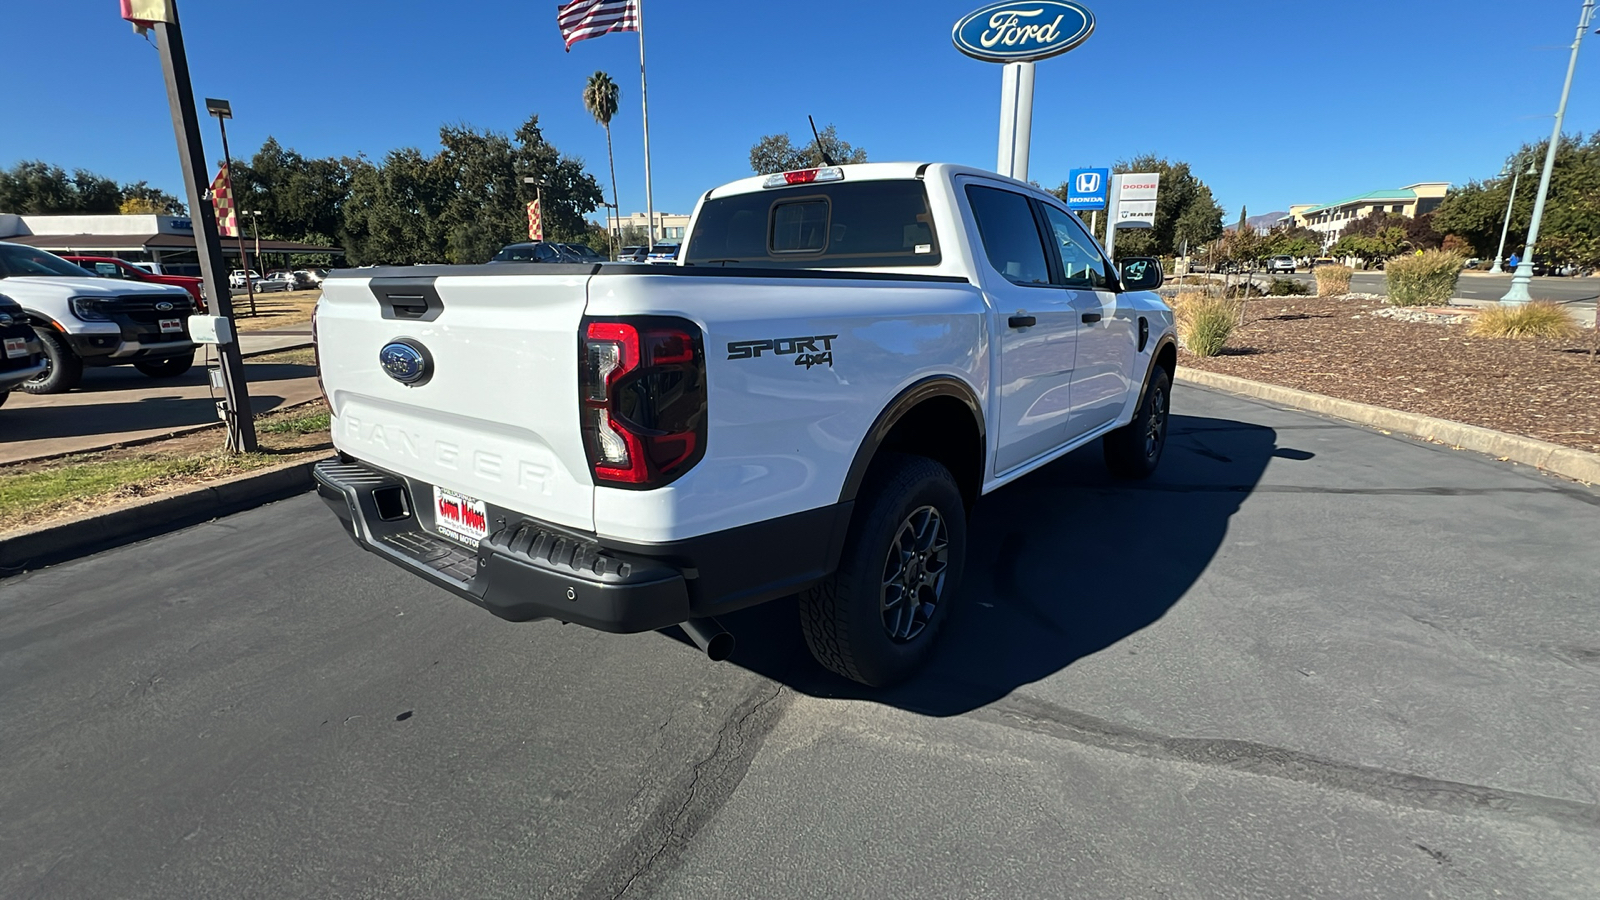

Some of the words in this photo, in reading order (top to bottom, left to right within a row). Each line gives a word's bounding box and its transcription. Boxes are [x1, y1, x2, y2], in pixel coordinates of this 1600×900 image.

[981, 8, 1064, 48] Ford
[727, 334, 838, 360] SPORT
[345, 415, 556, 497] RANGER
